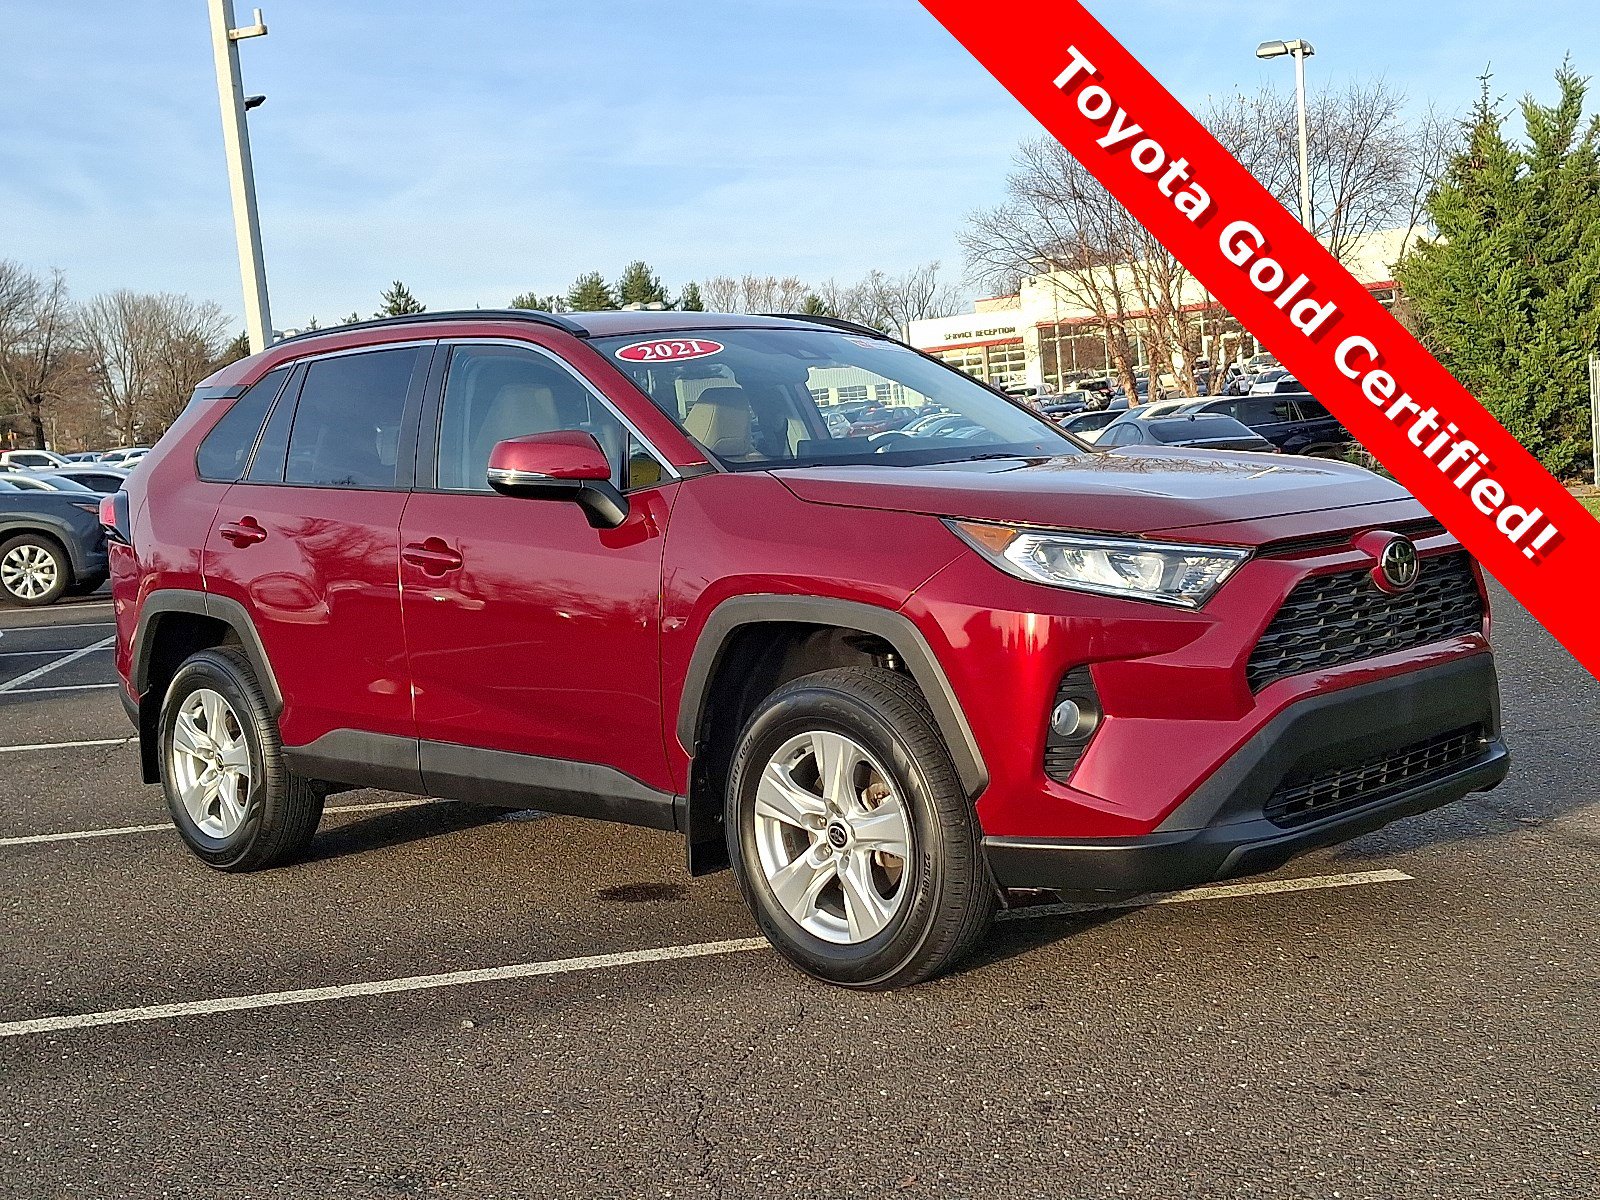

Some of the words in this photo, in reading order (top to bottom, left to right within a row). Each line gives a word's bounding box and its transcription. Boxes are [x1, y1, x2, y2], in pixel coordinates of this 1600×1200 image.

[944, 331, 972, 341] SERVICE
[975, 326, 1016, 337] RECEPTION
[637, 340, 705, 360] 2021
